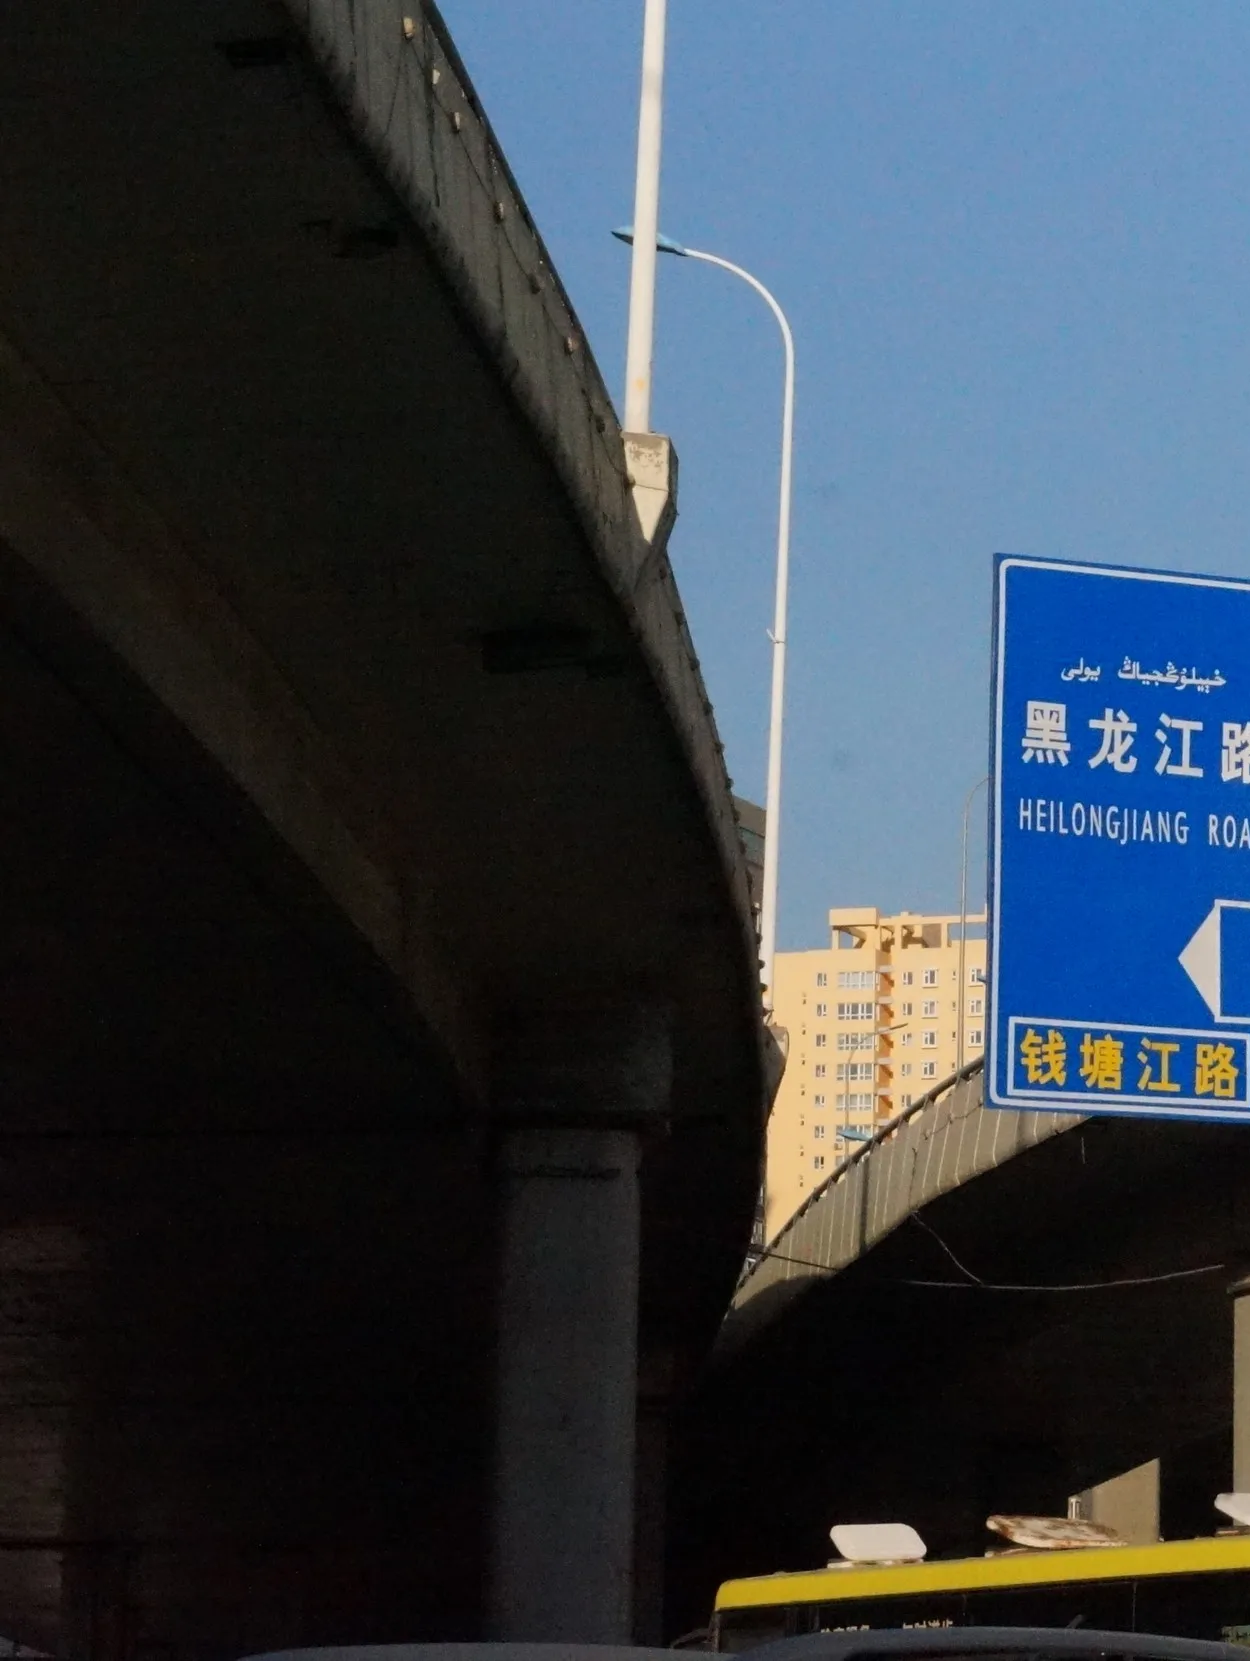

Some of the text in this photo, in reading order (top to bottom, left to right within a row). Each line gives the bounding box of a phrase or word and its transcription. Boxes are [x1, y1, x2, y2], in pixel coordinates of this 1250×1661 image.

[1019, 798, 1190, 846] HEILONGJIANG
[1020, 1028, 1239, 1099] 钱塘江路
